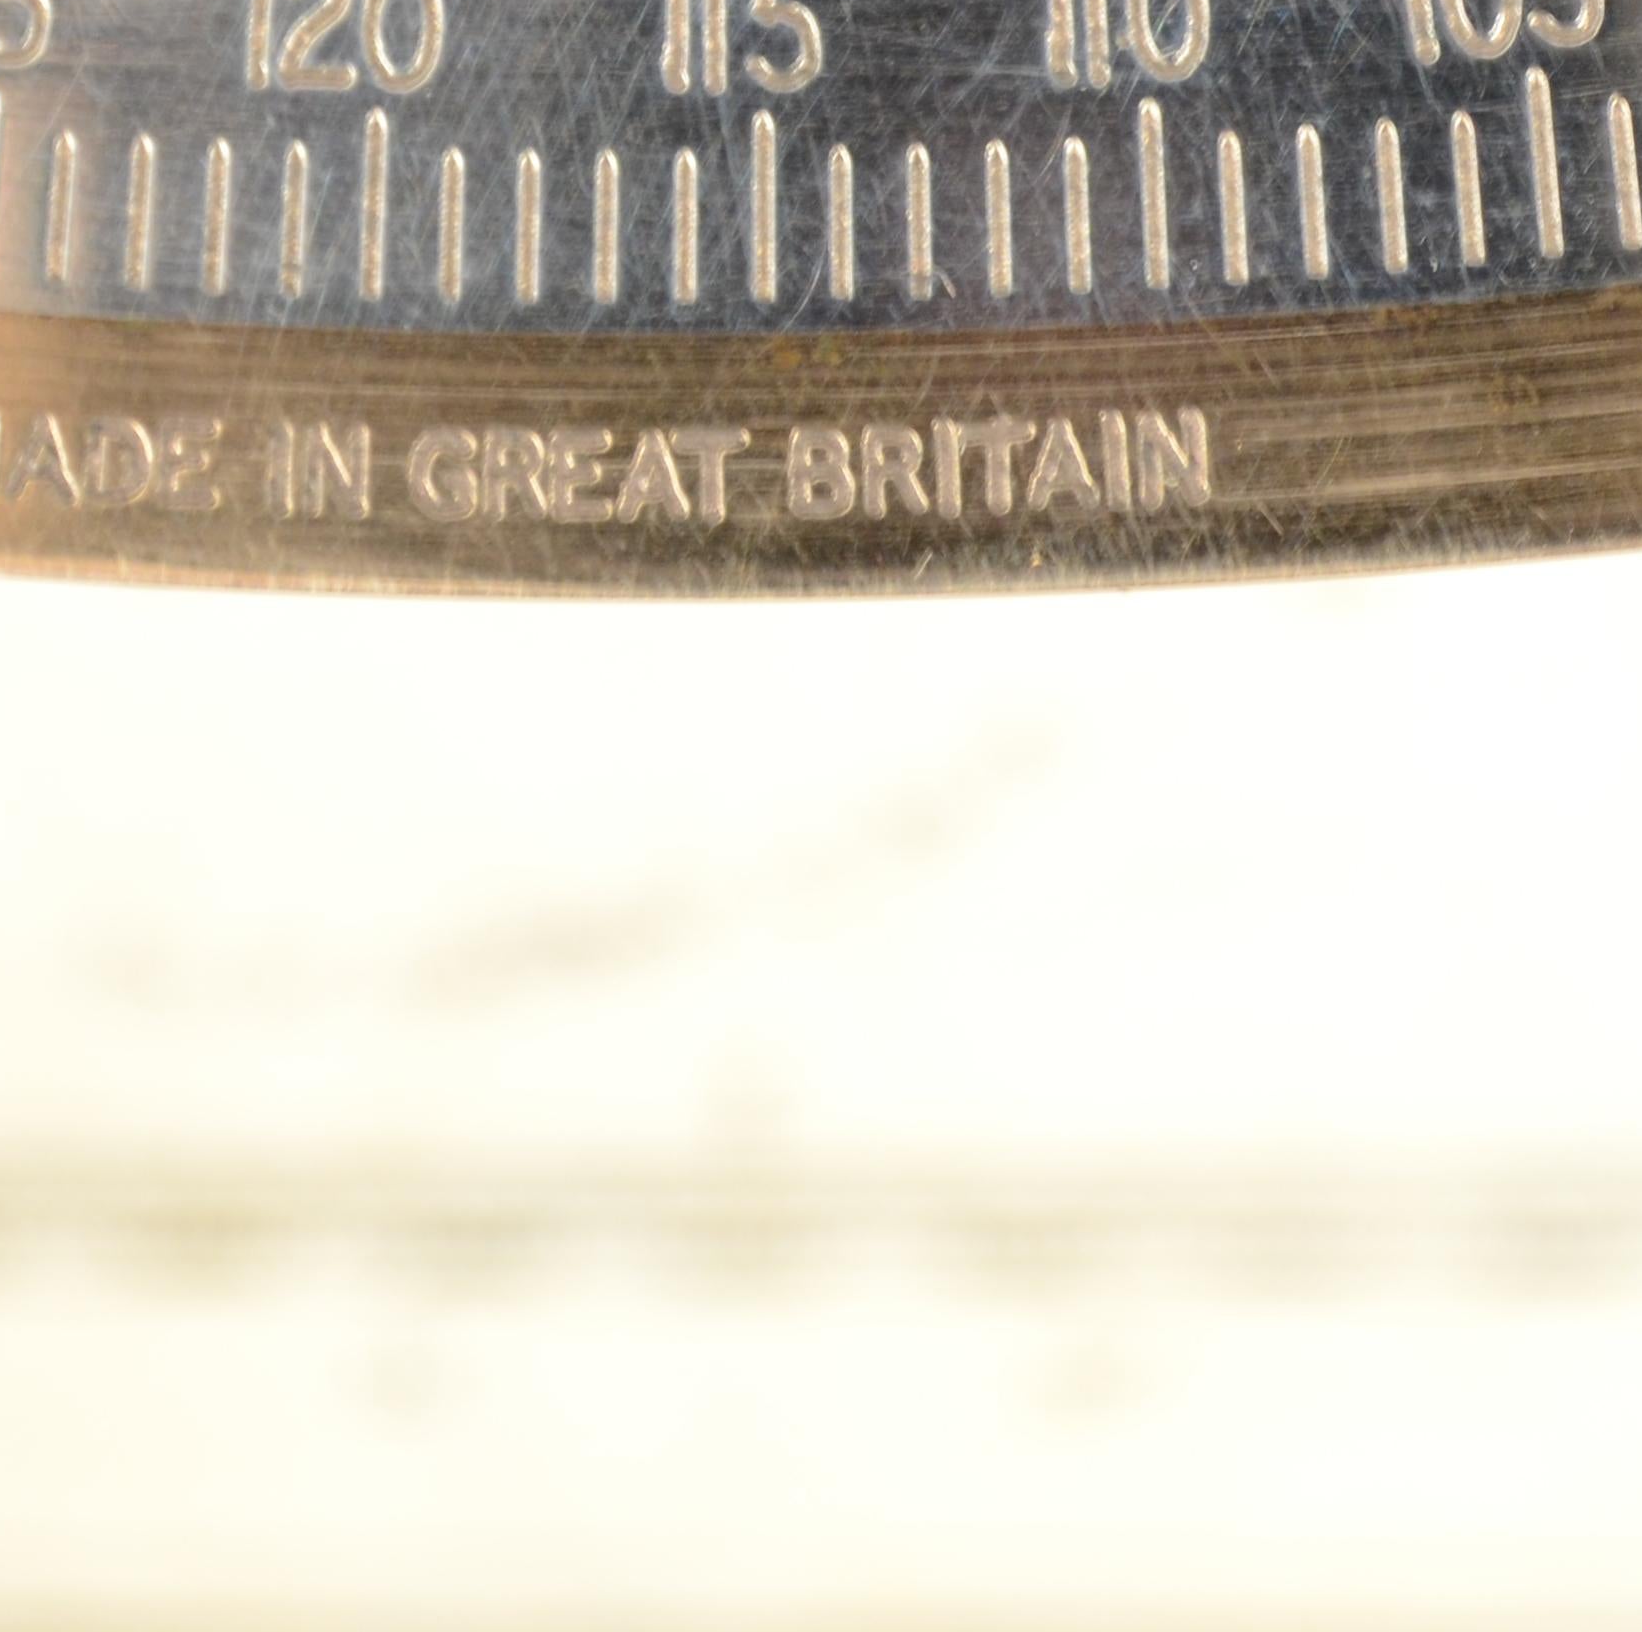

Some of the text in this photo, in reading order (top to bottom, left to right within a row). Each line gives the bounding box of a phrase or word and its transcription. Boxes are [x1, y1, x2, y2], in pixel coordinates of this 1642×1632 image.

[264, 423, 369, 518] IN
[407, 423, 751, 524] GREAT
[784, 408, 1211, 520] BRITAIN
